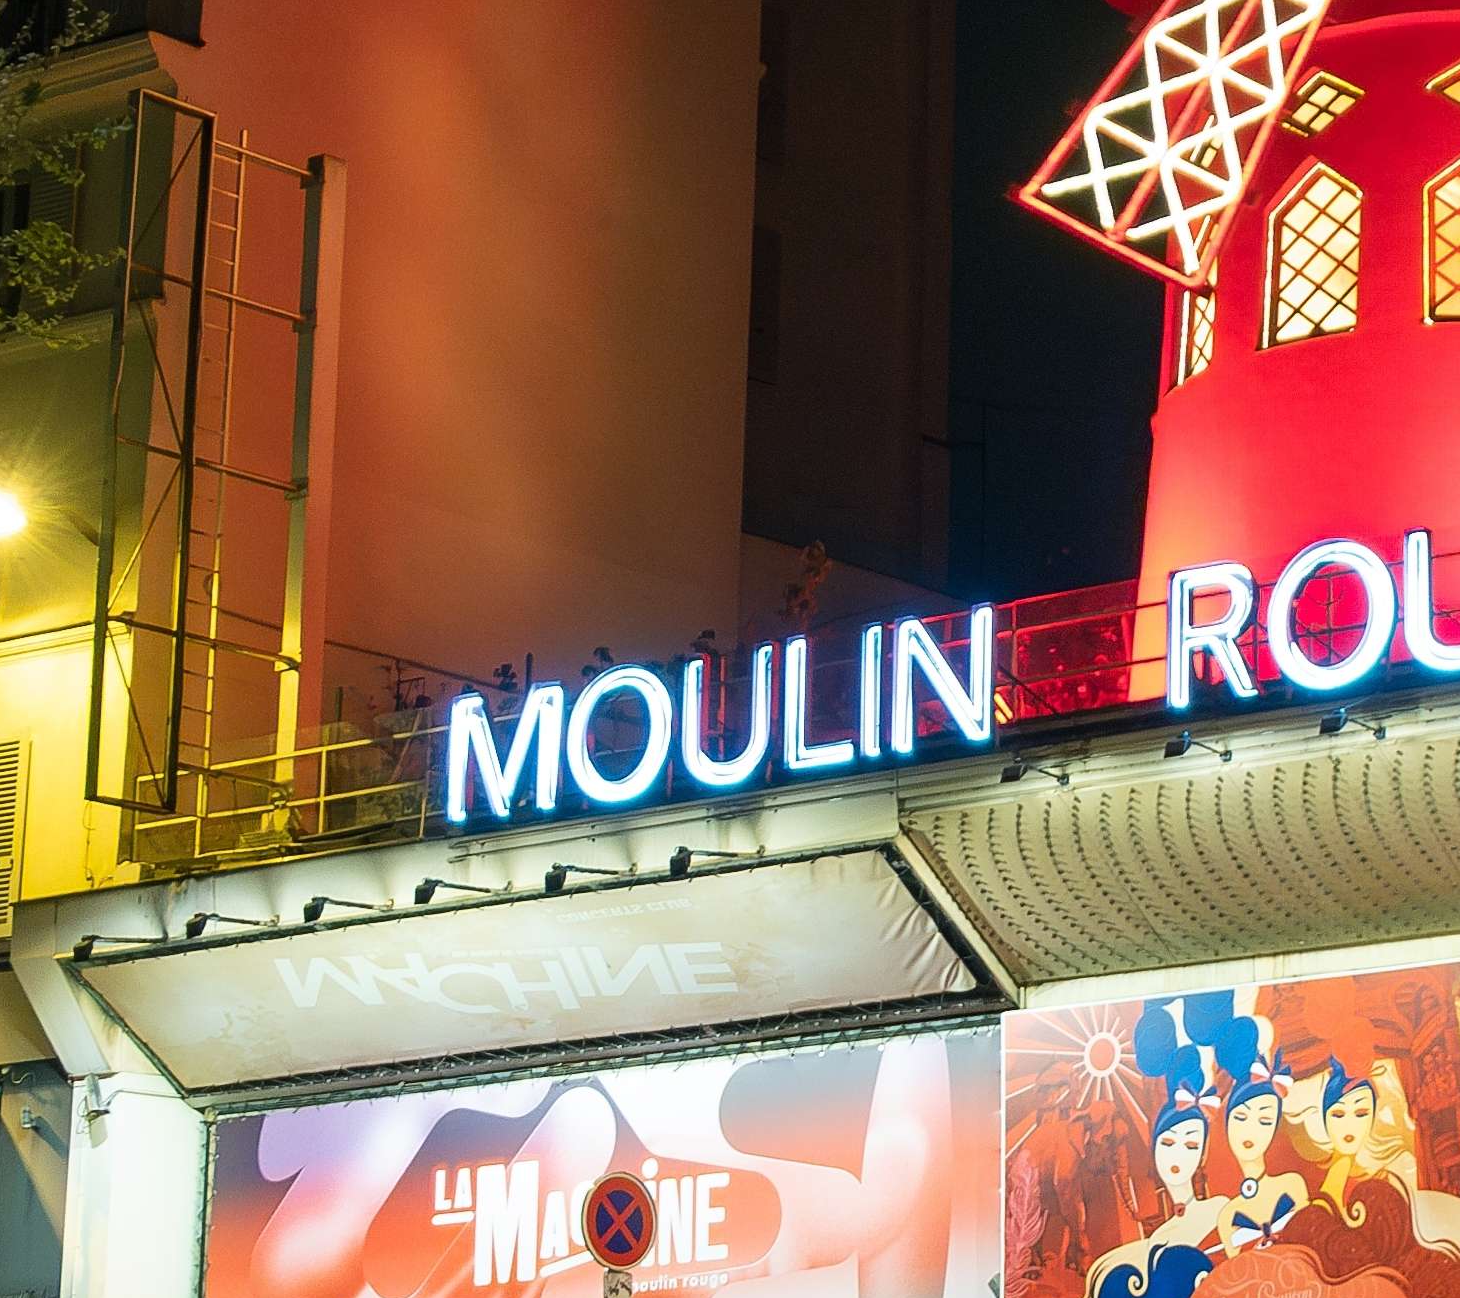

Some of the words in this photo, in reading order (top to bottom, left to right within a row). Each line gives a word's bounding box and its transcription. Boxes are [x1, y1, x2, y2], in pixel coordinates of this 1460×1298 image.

[446, 602, 995, 824] MOULIN
[433, 1167, 474, 1211] LA
[681, 1272, 729, 1292] rouge
